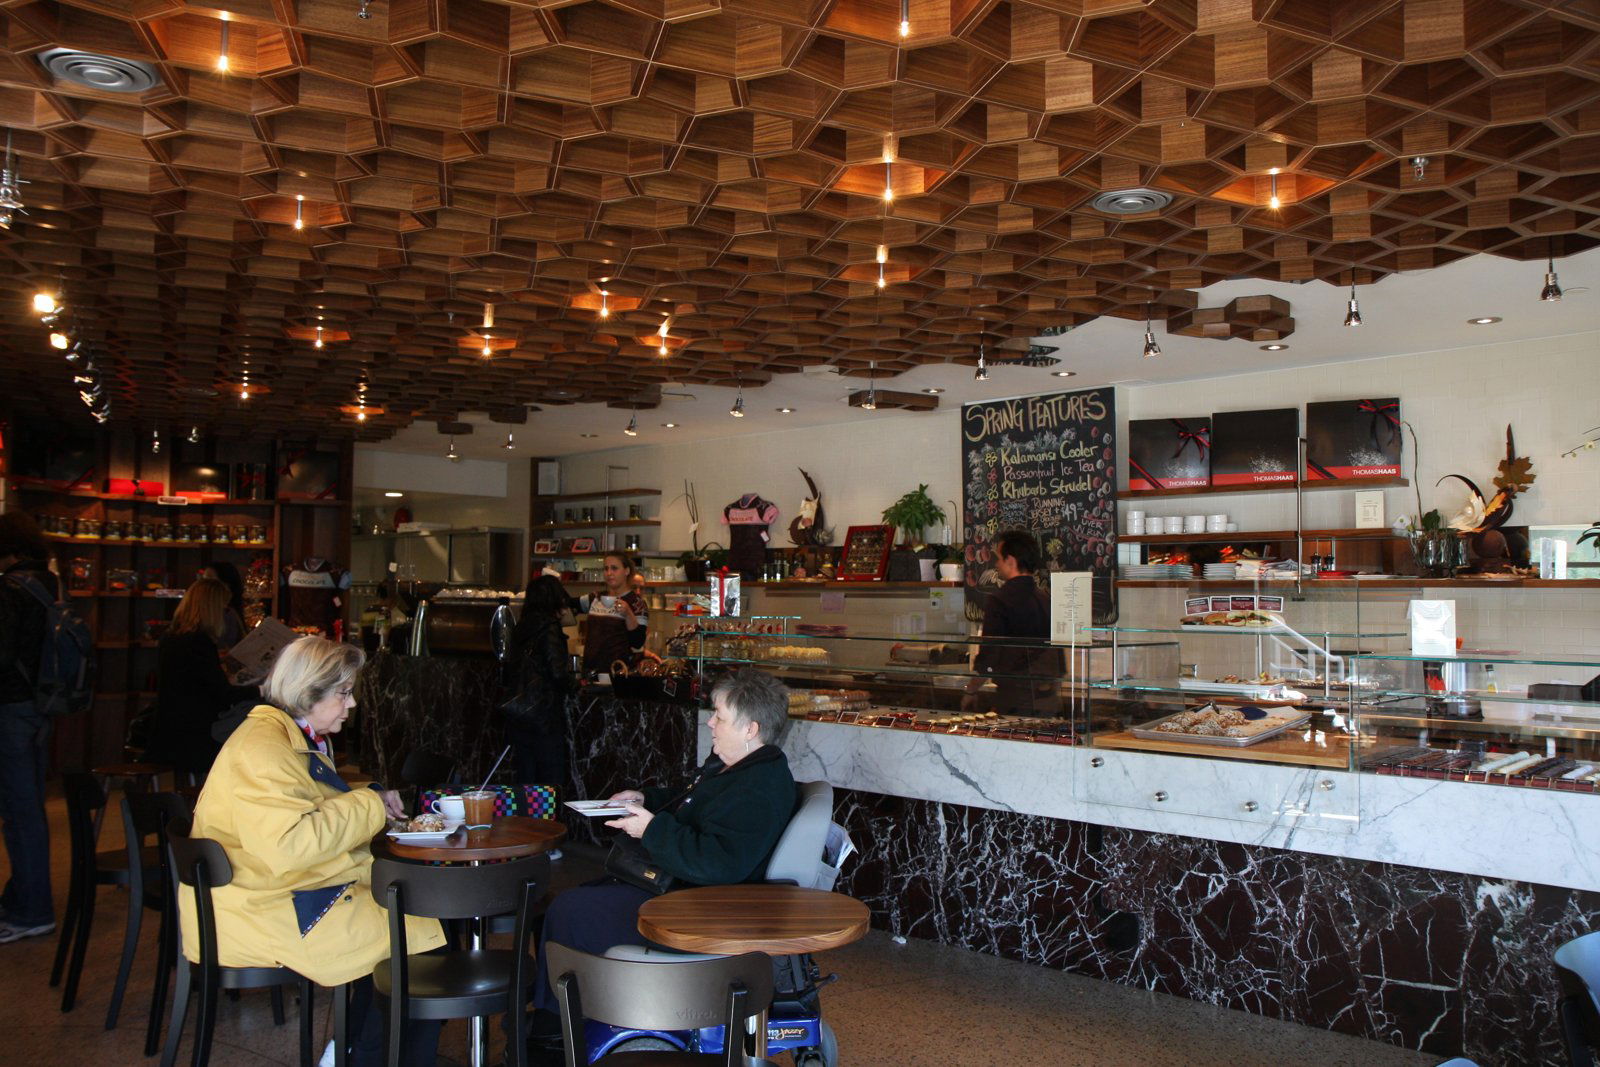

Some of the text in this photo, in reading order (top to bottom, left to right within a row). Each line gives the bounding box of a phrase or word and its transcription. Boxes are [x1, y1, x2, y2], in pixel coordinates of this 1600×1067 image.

[965, 392, 1107, 442] SPRING FEATURES
[1001, 440, 1099, 466] Kalamansi Cooler
[1003, 461, 1056, 480] Passionfruit
[1074, 459, 1095, 472] Tea
[1001, 474, 1092, 498] Rhubarb Strudel
